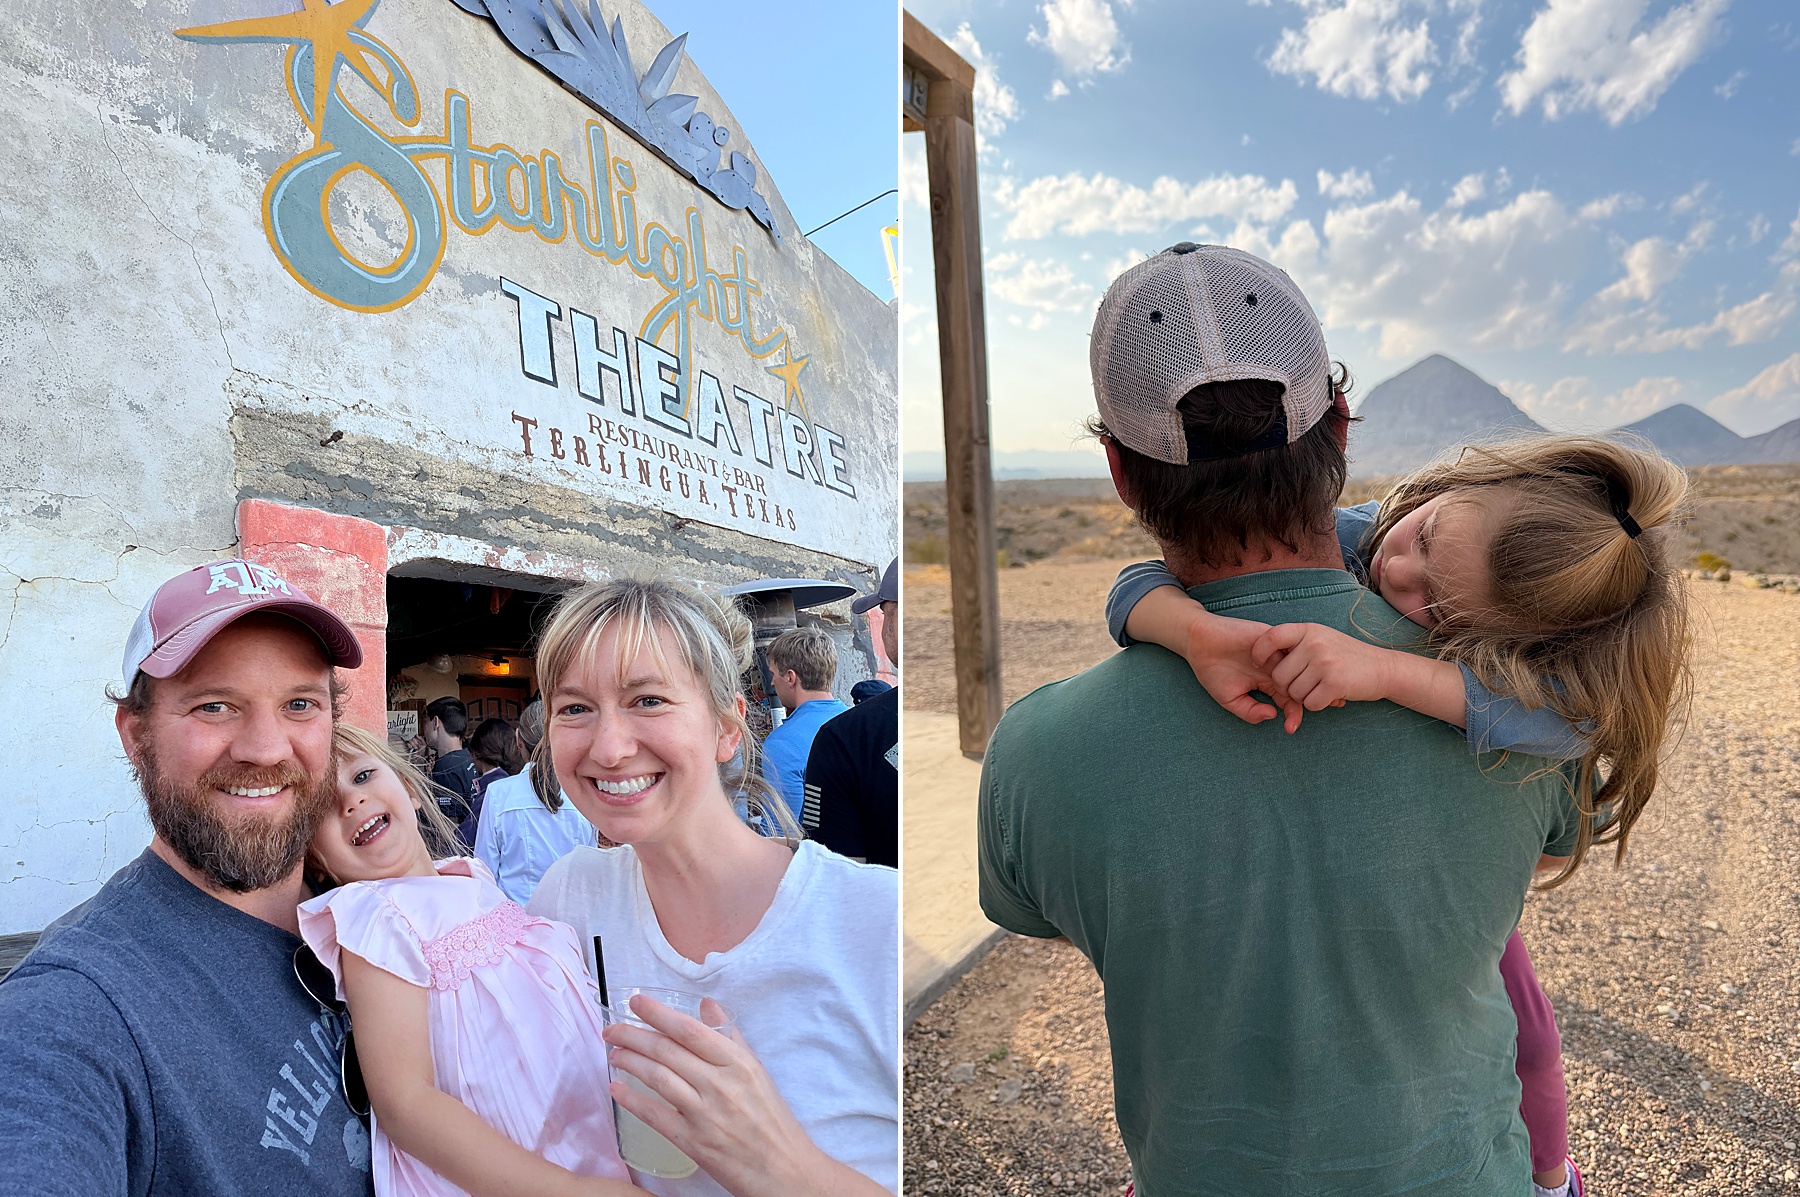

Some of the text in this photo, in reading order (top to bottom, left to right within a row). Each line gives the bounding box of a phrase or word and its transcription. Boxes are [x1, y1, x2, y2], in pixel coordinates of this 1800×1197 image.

[264, 29, 787, 420] Starlight
[500, 275, 858, 500] THEATRE
[511, 409, 797, 532] TERLINGUA, TEXAS
[586, 412, 768, 497] RESTAURANT & BAR
[386, 711, 417, 734] arlight
